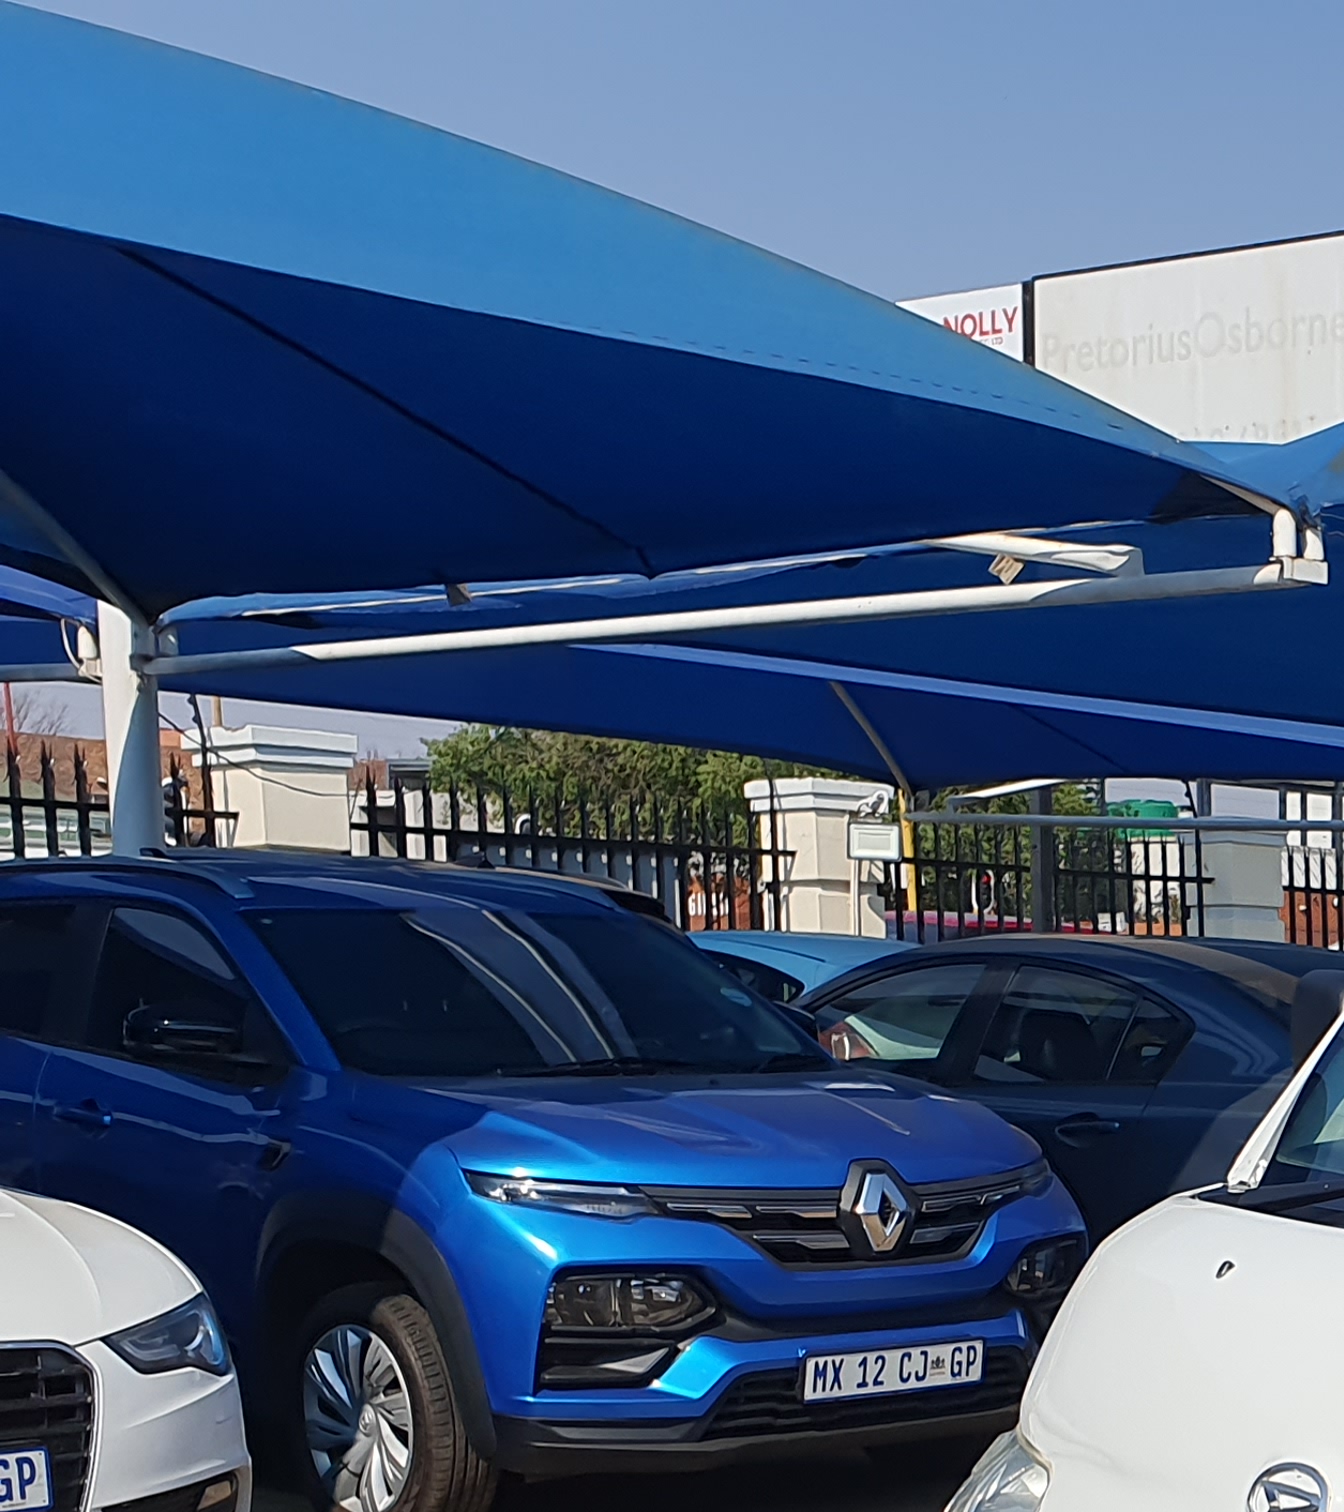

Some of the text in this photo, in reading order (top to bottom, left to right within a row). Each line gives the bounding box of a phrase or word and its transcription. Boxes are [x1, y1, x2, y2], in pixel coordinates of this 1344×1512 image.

[943, 306, 1018, 338] NOLLY
[812, 1345, 978, 1394] MX 12 CJ GP
